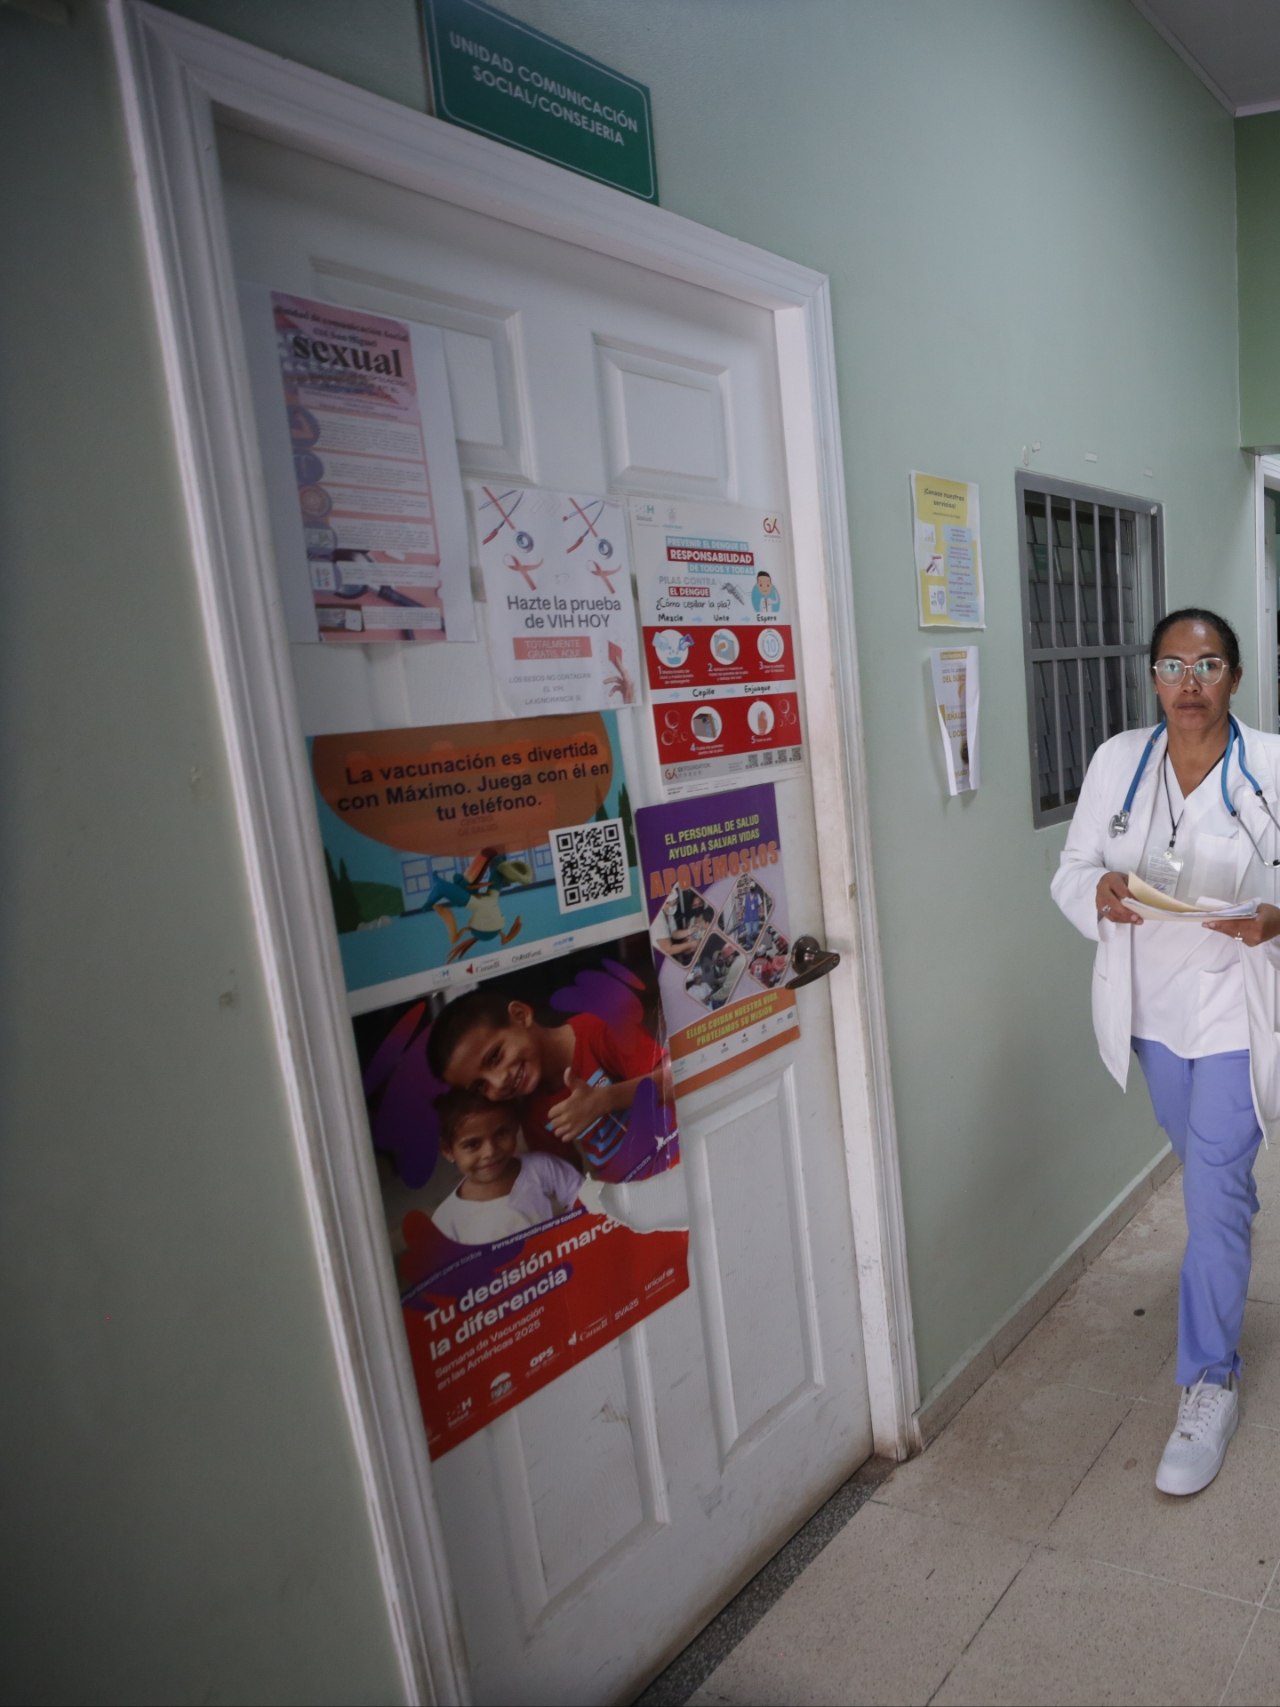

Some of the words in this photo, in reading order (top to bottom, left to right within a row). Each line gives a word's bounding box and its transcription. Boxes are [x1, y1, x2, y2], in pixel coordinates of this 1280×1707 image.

[449, 31, 514, 74] UNIDAD
[517, 65, 638, 133] COMUNICACIÓN
[472, 65, 624, 146] SOCIAL/CONSEJERIA
[292, 335, 403, 378] sexual
[667, 539, 701, 549] PREVENIR
[711, 541, 739, 550] DENGUE
[670, 550, 752, 563] RESPONSABILIDAD
[659, 575, 681, 585] PILAS
[683, 576, 716, 586] CONTRA
[689, 564, 698, 572] DE
[699, 564, 724, 573] TODOS
[732, 565, 754, 574] TODAS
[507, 595, 551, 611] Hazte
[553, 595, 567, 611] la
[570, 596, 621, 614] prueba
[670, 588, 678, 596] EL
[680, 588, 709, 596] DENGUE
[708, 599, 716, 608] la
[525, 613, 545, 629] de
[547, 614, 574, 629] VIH
[578, 614, 610, 629] HOY
[658, 613, 684, 622] Mezcle
[713, 613, 730, 622] Unte
[525, 639, 581, 650] TOTALMENTE
[744, 684, 772, 695] Enjuague
[346, 766, 373, 785] La
[379, 751, 496, 781] vacunación
[502, 752, 522, 766] es
[528, 742, 598, 763] divertida
[337, 794, 379, 812] con
[386, 781, 471, 805] Máximo.
[478, 773, 532, 793] Juega
[537, 769, 567, 784] con
[572, 763, 586, 778] él
[591, 762, 609, 775] en
[436, 804, 456, 821] tu
[462, 793, 541, 817] teléfono.
[665, 833, 676, 846] EL
[678, 823, 722, 842] PERSONAL
[724, 820, 735, 832] DE
[736, 814, 760, 830] SALUD
[669, 844, 699, 861] AYUDA
[700, 841, 707, 852] A
[708, 835, 738, 850] SALVAR
[738, 828, 760, 843] VIDAS
[650, 840, 779, 899] APOYÉMOSLOS
[541, 1218, 560, 1232] para
[561, 1209, 582, 1222] todos
[424, 1303, 455, 1332] Tu
[459, 1249, 552, 1313] decisión
[429, 1337, 451, 1361] la
[455, 1267, 568, 1344] diferencia
[435, 1348, 475, 1379] Semana
[476, 1339, 489, 1352] de
[490, 1306, 545, 1342] Vacunación
[452, 1368, 465, 1382] las
[468, 1338, 514, 1370] Américas
[515, 1319, 541, 1342] 2025
[530, 1346, 555, 1367] OPS
